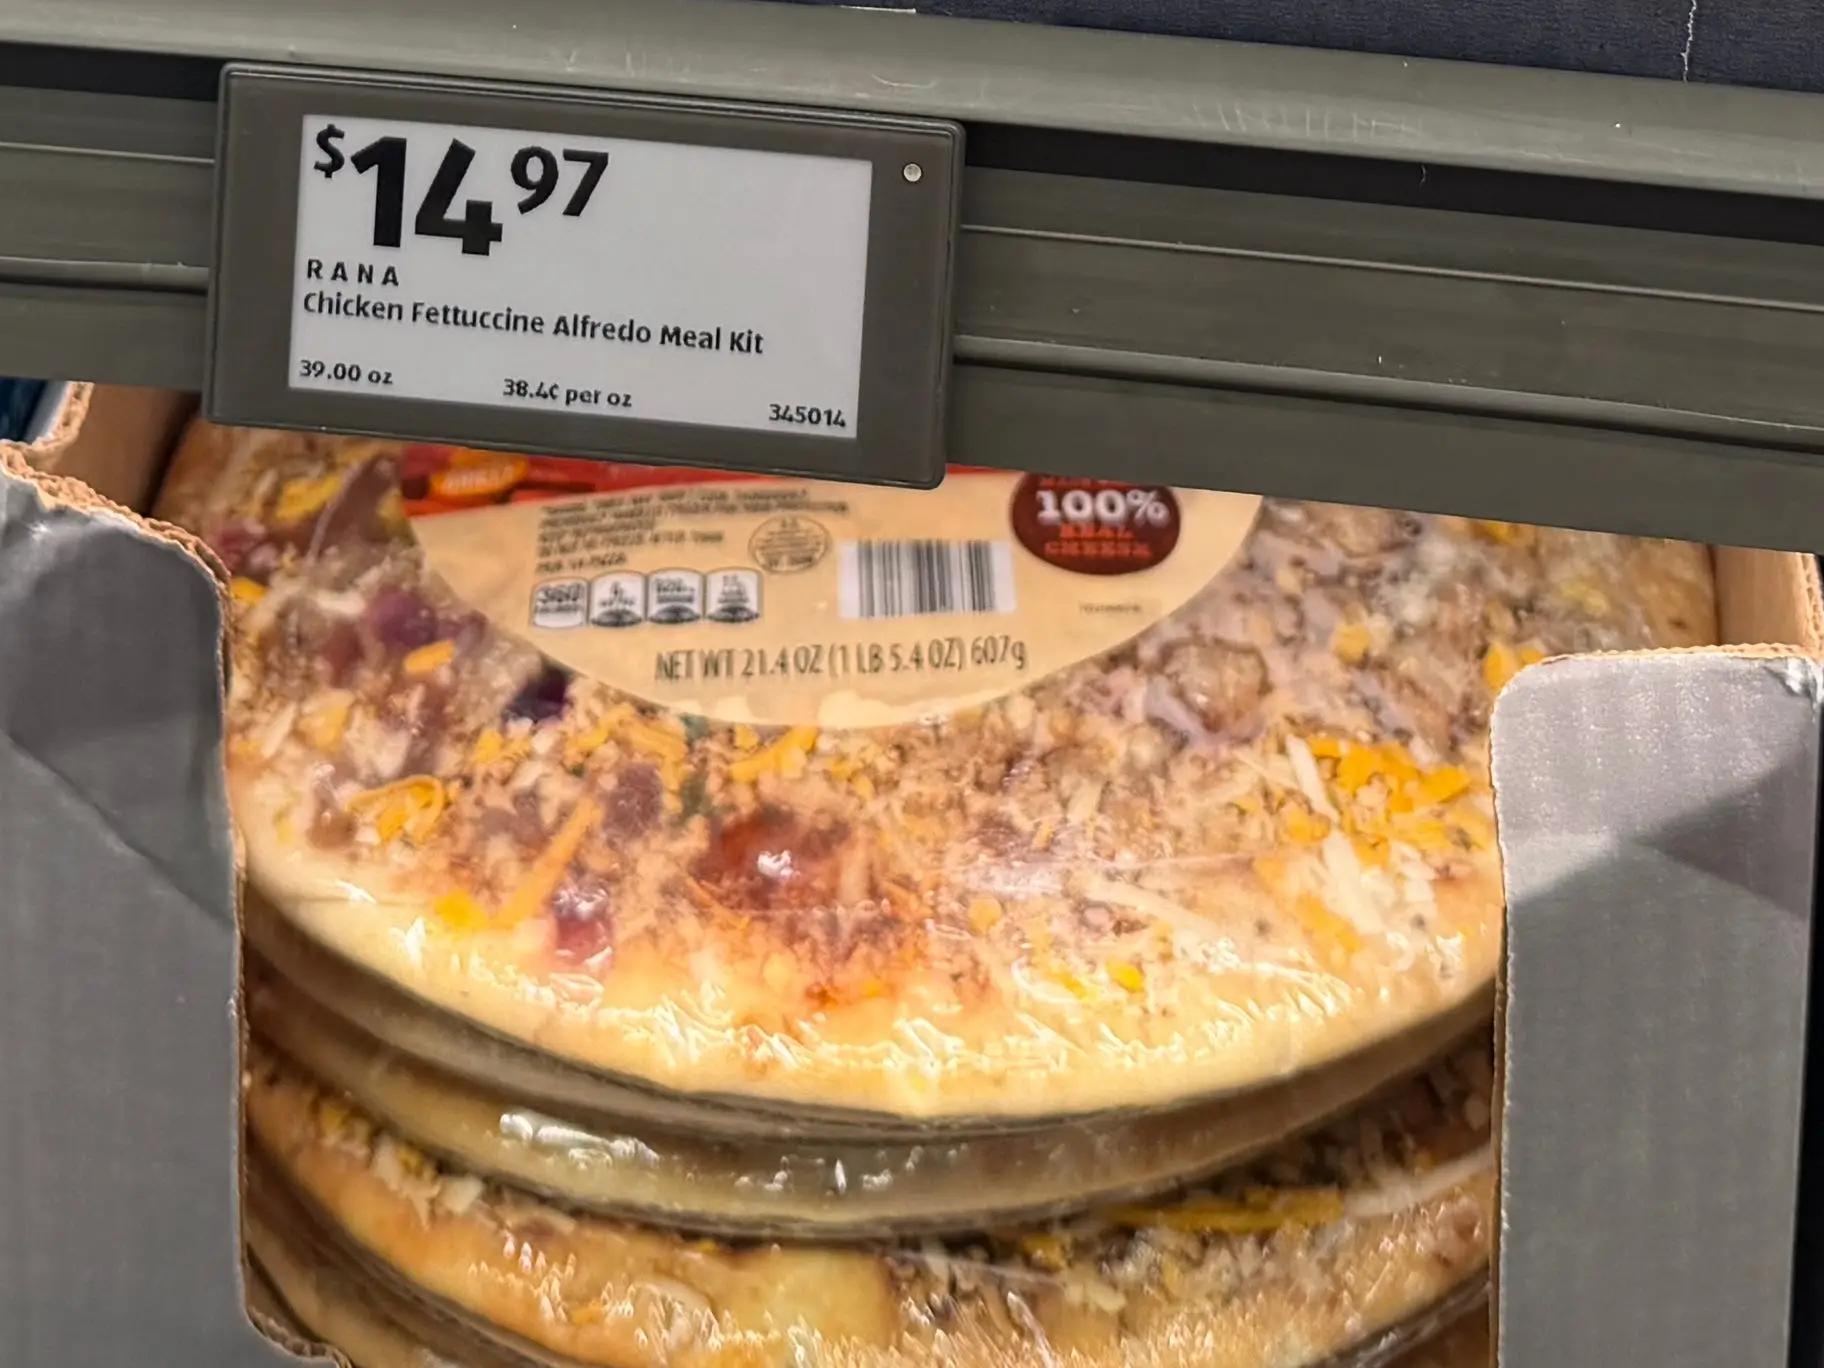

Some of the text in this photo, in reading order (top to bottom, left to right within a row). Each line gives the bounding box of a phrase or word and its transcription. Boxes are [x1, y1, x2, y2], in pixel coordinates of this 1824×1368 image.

[303, 291, 764, 355] Chicken Fettuccine Alfredo Meal Kit
[299, 360, 393, 386] 39.00 oz
[565, 386, 601, 409] per
[607, 390, 633, 408] oz
[768, 403, 846, 429] 345014
[1037, 490, 1169, 524] 100%
[655, 649, 699, 682] NET
[701, 647, 735, 679] WT
[741, 646, 788, 677] 21.4
[793, 645, 821, 674] OZ
[856, 644, 880, 673] LB
[891, 642, 924, 672] 5.4
[928, 639, 964, 670] OZ)
[971, 634, 1025, 671] 607g
